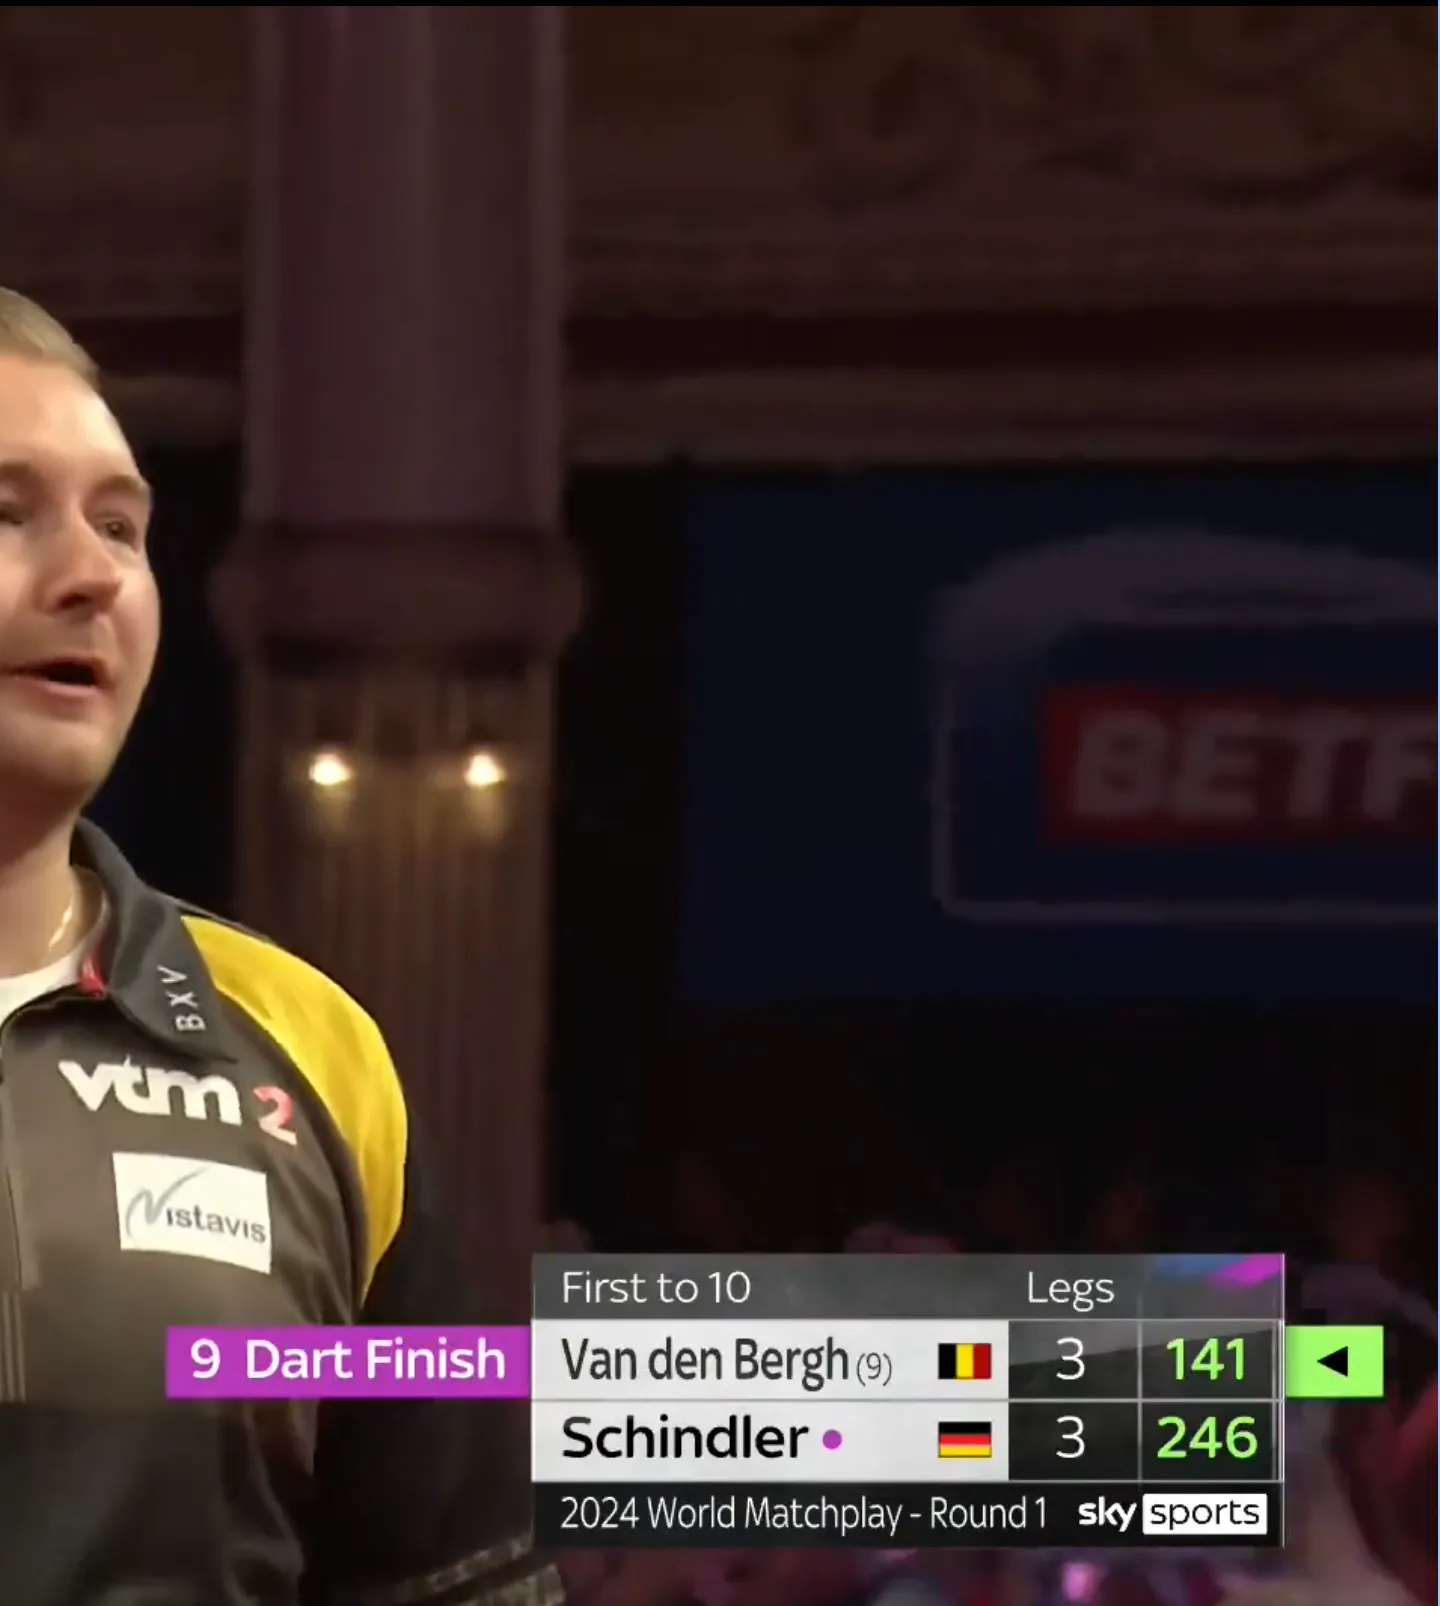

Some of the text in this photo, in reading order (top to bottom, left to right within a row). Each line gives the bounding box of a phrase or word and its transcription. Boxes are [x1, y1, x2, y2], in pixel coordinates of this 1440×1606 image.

[58, 1054, 297, 1146] vtm 2
[124, 1166, 267, 1244] Nistavis
